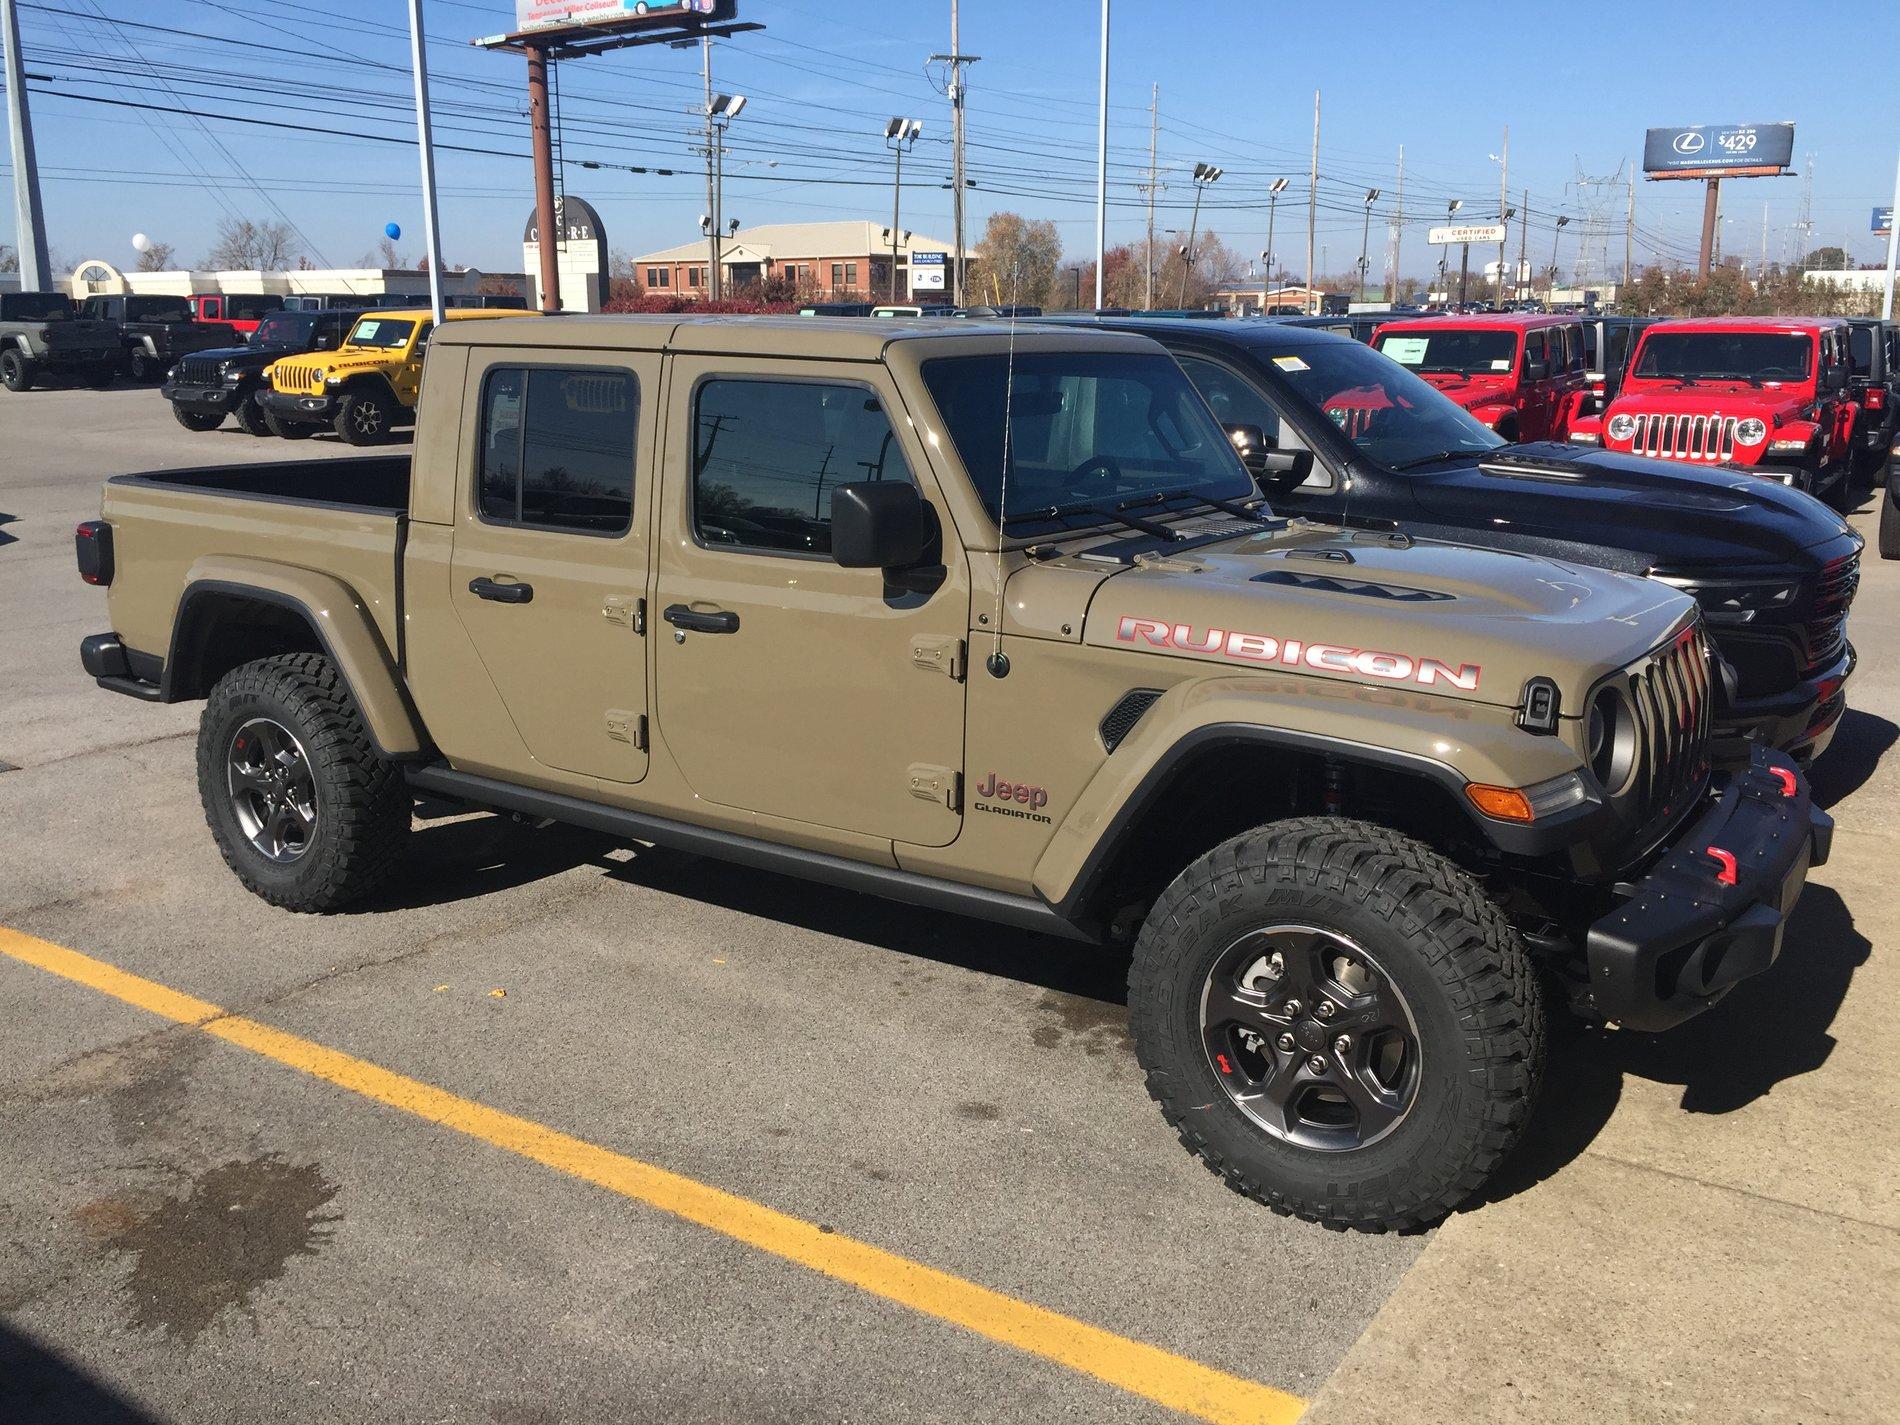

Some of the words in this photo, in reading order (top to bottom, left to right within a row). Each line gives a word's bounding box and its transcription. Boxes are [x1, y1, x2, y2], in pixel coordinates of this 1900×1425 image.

[564, 5, 584, 14] Miller
[584, 0, 618, 11] Coliseum
[1718, 134, 1757, 151] $429
[1451, 228, 1497, 236] CERTIFIED
[338, 359, 390, 368] RUBICON
[1116, 615, 1482, 691] RUBICON
[976, 770, 1048, 812] Jeep
[974, 802, 1052, 825] GLADIATOR
[1264, 887, 1353, 915] M/T
